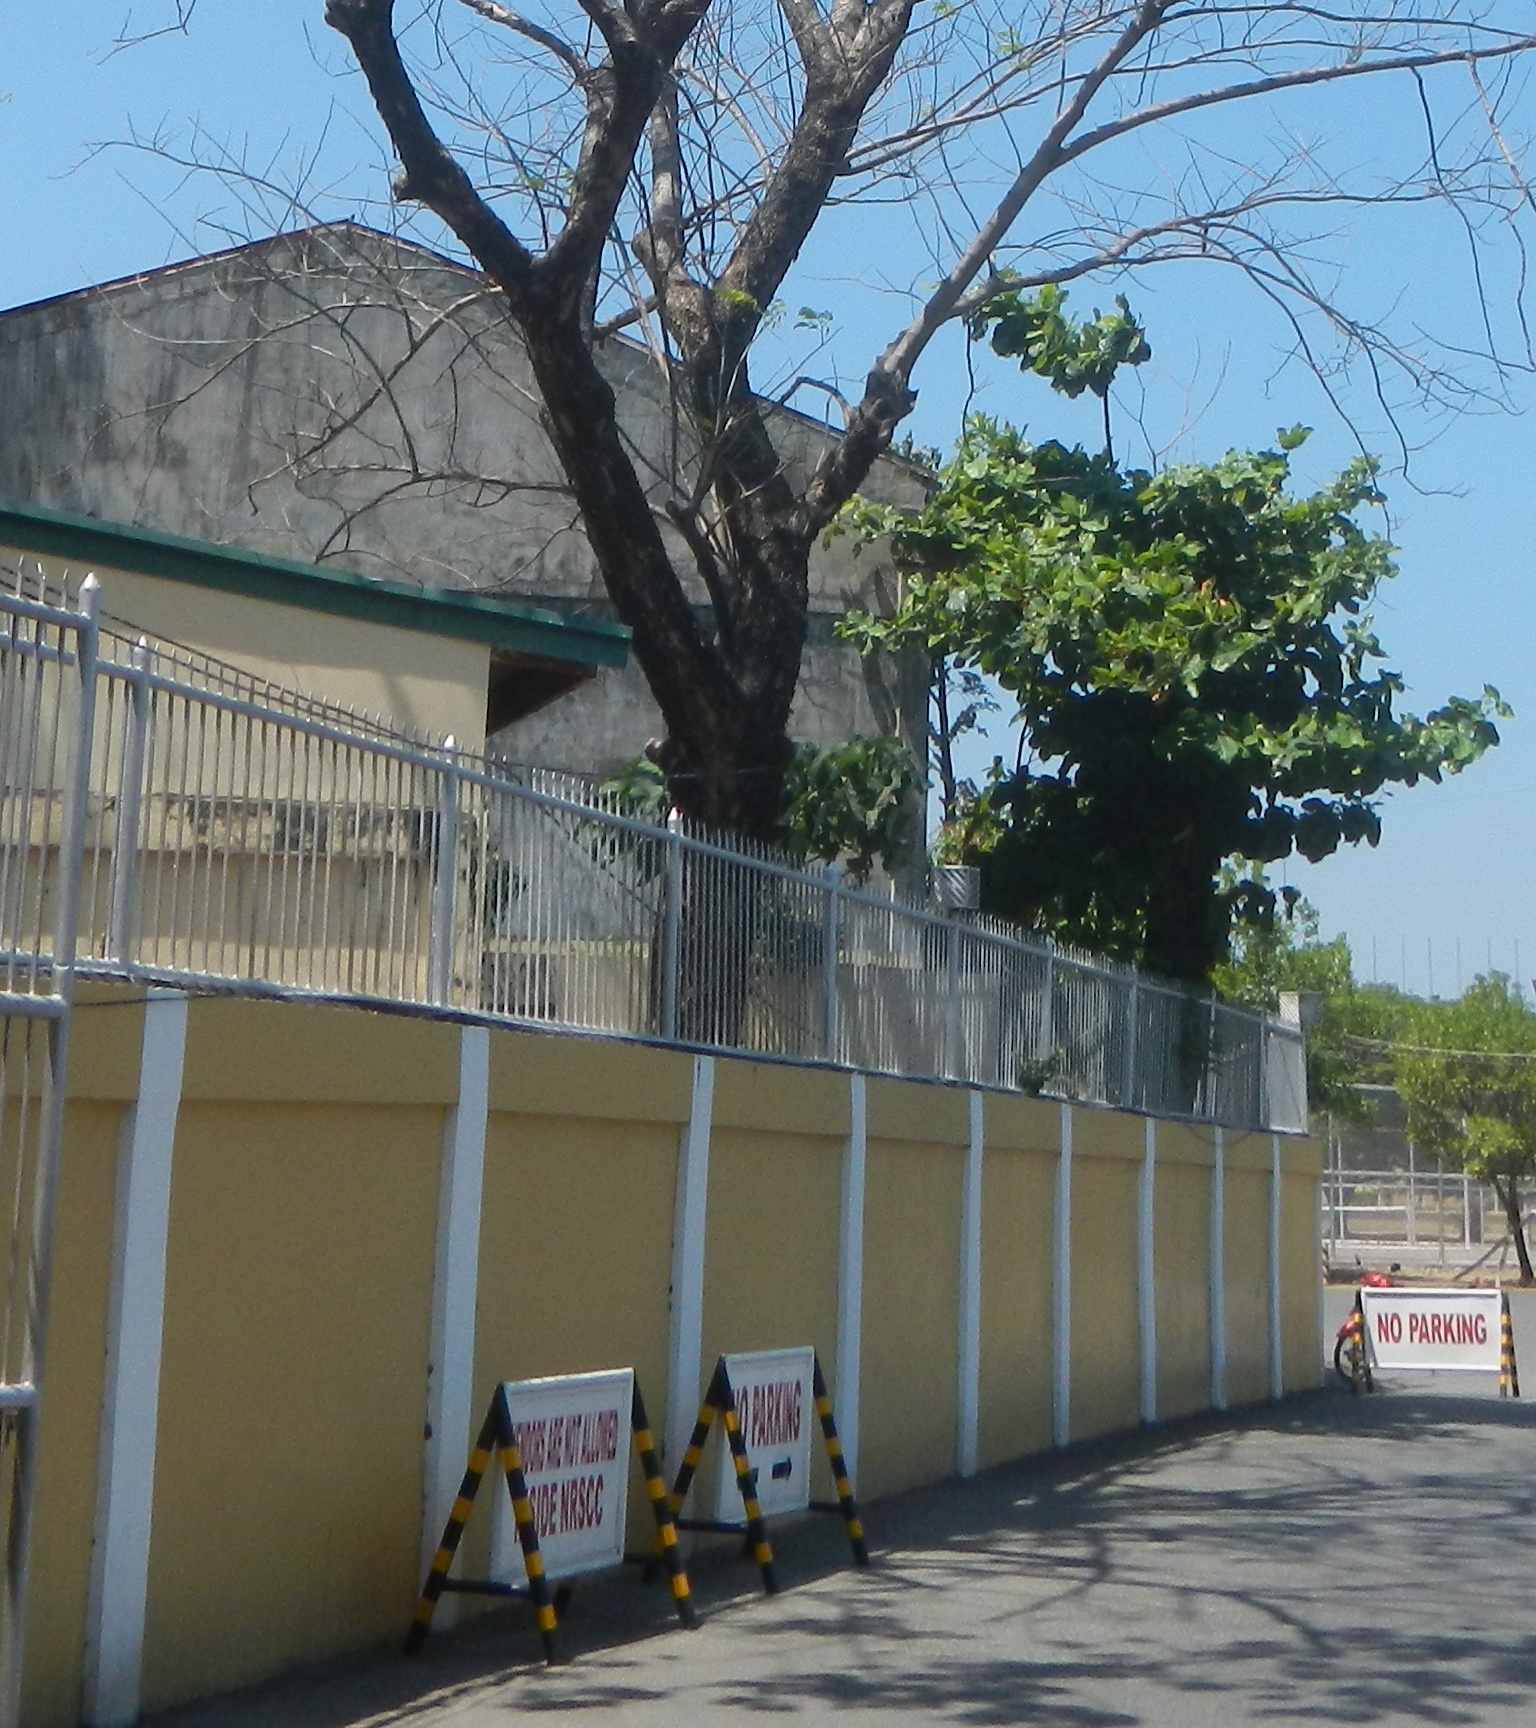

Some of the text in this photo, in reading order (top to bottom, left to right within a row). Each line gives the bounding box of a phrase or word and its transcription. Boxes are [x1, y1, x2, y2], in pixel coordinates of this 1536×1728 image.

[1377, 1312, 1488, 1345] NO PARKING
[751, 1379, 801, 1448] PARKING
[514, 1474, 604, 1544] SIDE NRSCC
